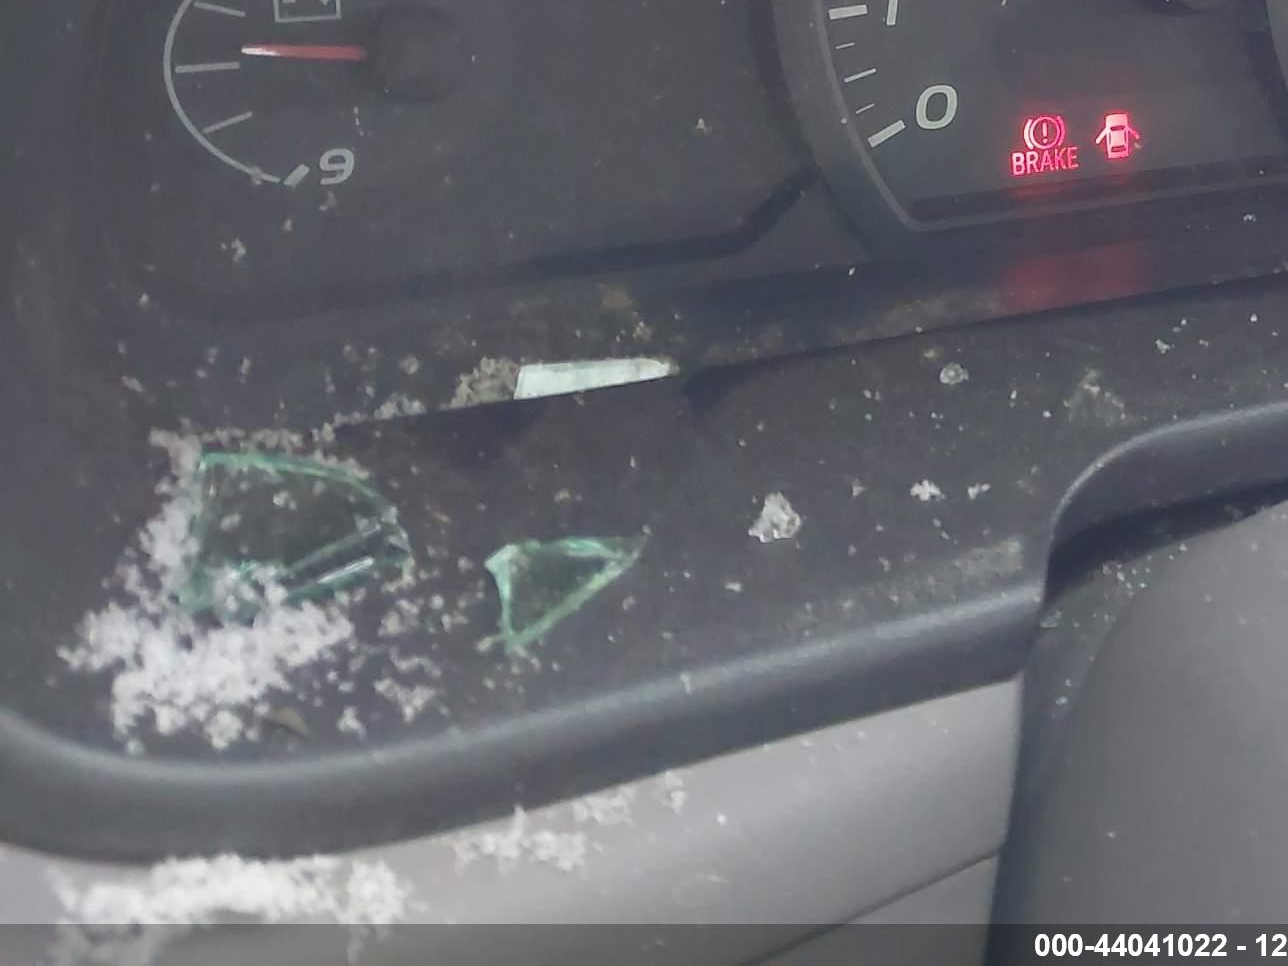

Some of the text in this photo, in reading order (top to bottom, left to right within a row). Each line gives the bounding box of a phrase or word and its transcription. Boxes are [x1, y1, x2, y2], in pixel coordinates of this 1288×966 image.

[916, 85, 957, 129] 0
[320, 149, 354, 184] 9
[1011, 147, 1079, 176] BRAKE
